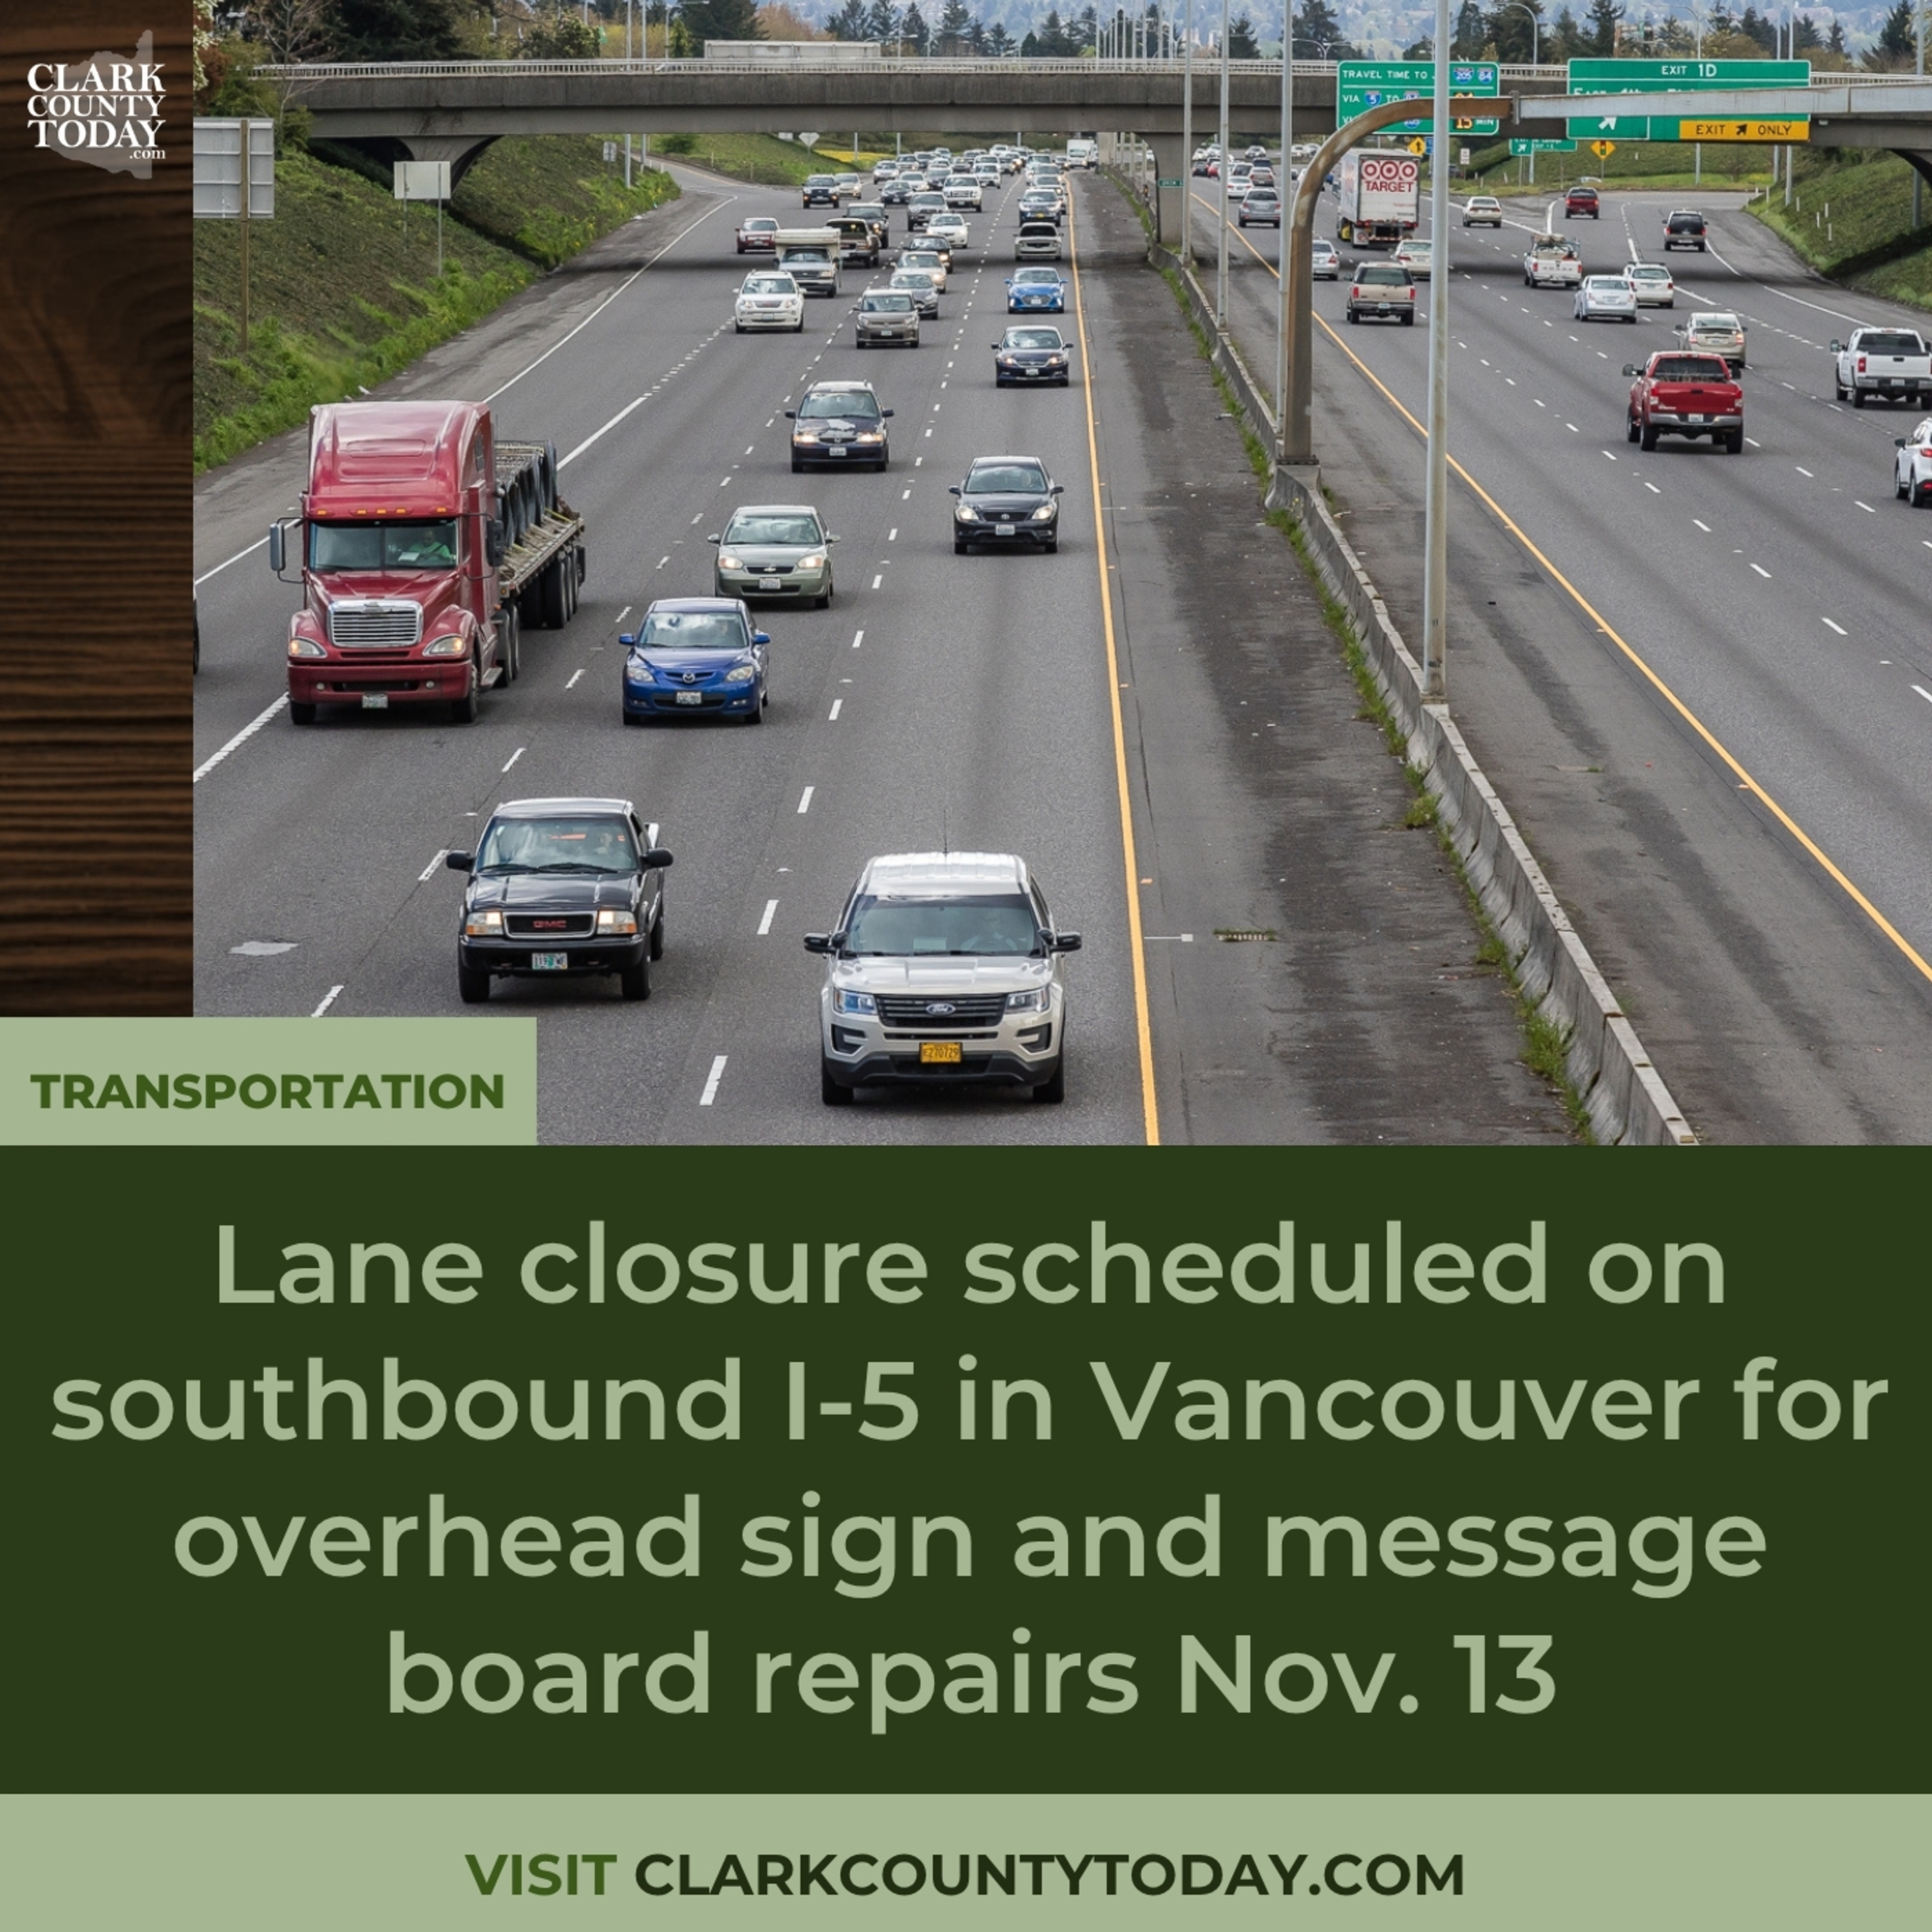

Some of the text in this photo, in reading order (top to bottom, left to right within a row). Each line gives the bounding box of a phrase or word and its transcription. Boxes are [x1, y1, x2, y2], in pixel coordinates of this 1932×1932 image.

[1343, 70, 1382, 79] TRAVEL
[1387, 71, 1410, 79] TIME
[1662, 64, 1718, 77] EXIT 1D
[1369, 95, 1377, 104] 5
[1696, 125, 1792, 135] EXIT ONLY
[1365, 180, 1414, 193] TARGET
